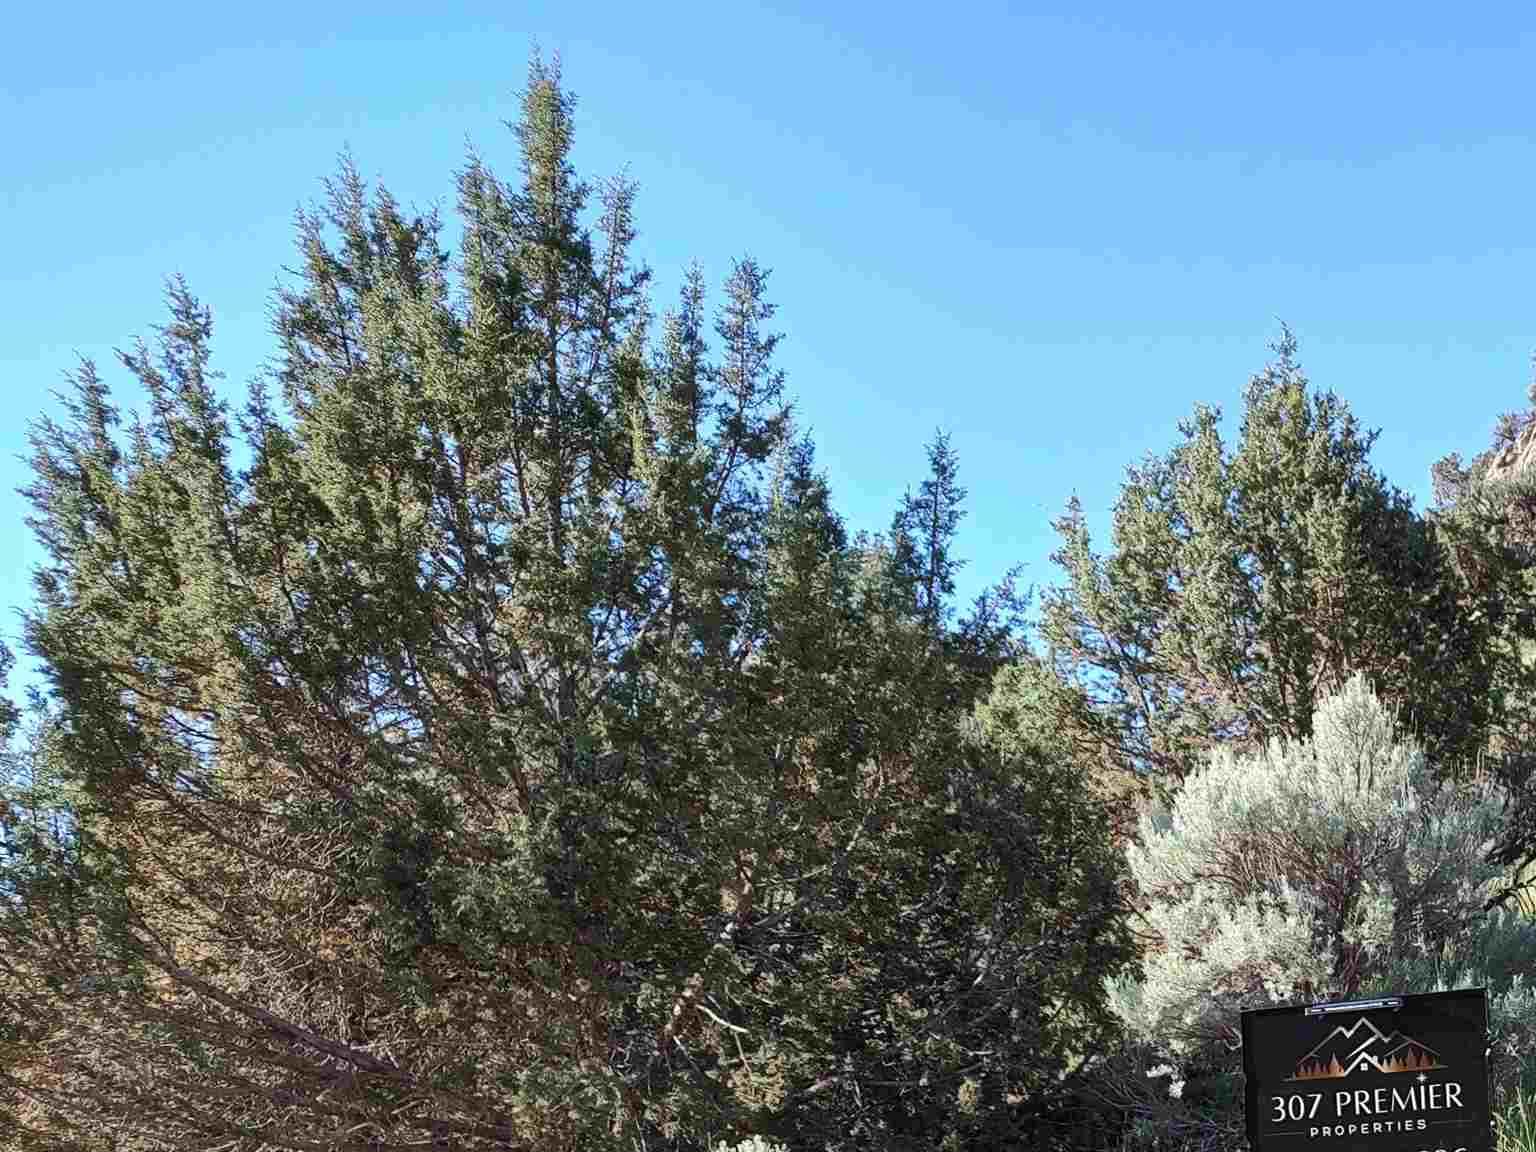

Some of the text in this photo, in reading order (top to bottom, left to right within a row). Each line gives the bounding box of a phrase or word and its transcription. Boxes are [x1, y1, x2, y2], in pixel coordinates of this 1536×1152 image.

[1271, 1082, 1465, 1123] 307 PREMIER
[1310, 1119, 1428, 1137] PROPERTIES
